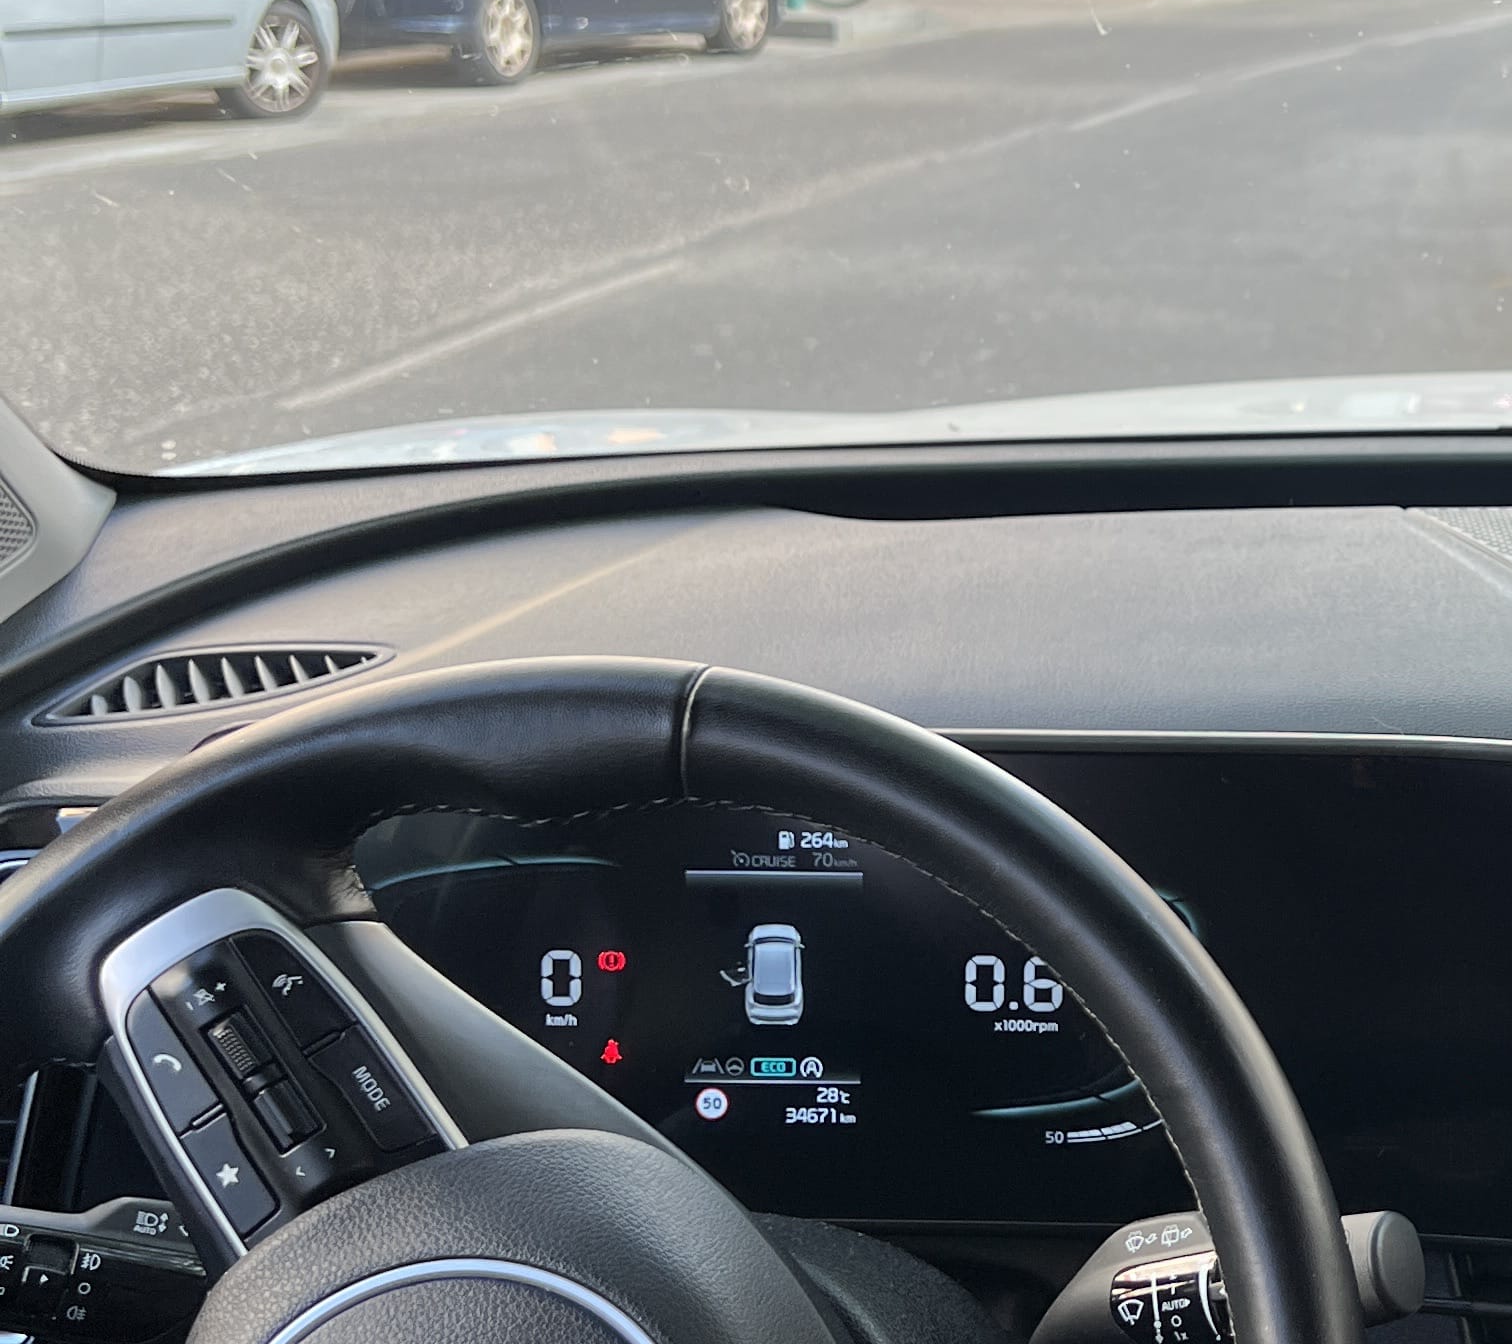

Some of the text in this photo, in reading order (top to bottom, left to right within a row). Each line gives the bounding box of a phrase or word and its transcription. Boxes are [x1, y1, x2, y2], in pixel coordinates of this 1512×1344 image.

[751, 854, 797, 868] CRUISE
[541, 949, 582, 1007] 0
[964, 955, 1064, 1012] 0.6
[545, 1013, 578, 1027] km/h
[993, 1018, 1060, 1034] x1000rpm
[760, 1060, 787, 1073] ECO
[352, 1065, 391, 1111] MODE
[702, 1096, 723, 1110] 50
[1045, 1130, 1065, 1144] 50
[133, 1224, 157, 1236] AUTO
